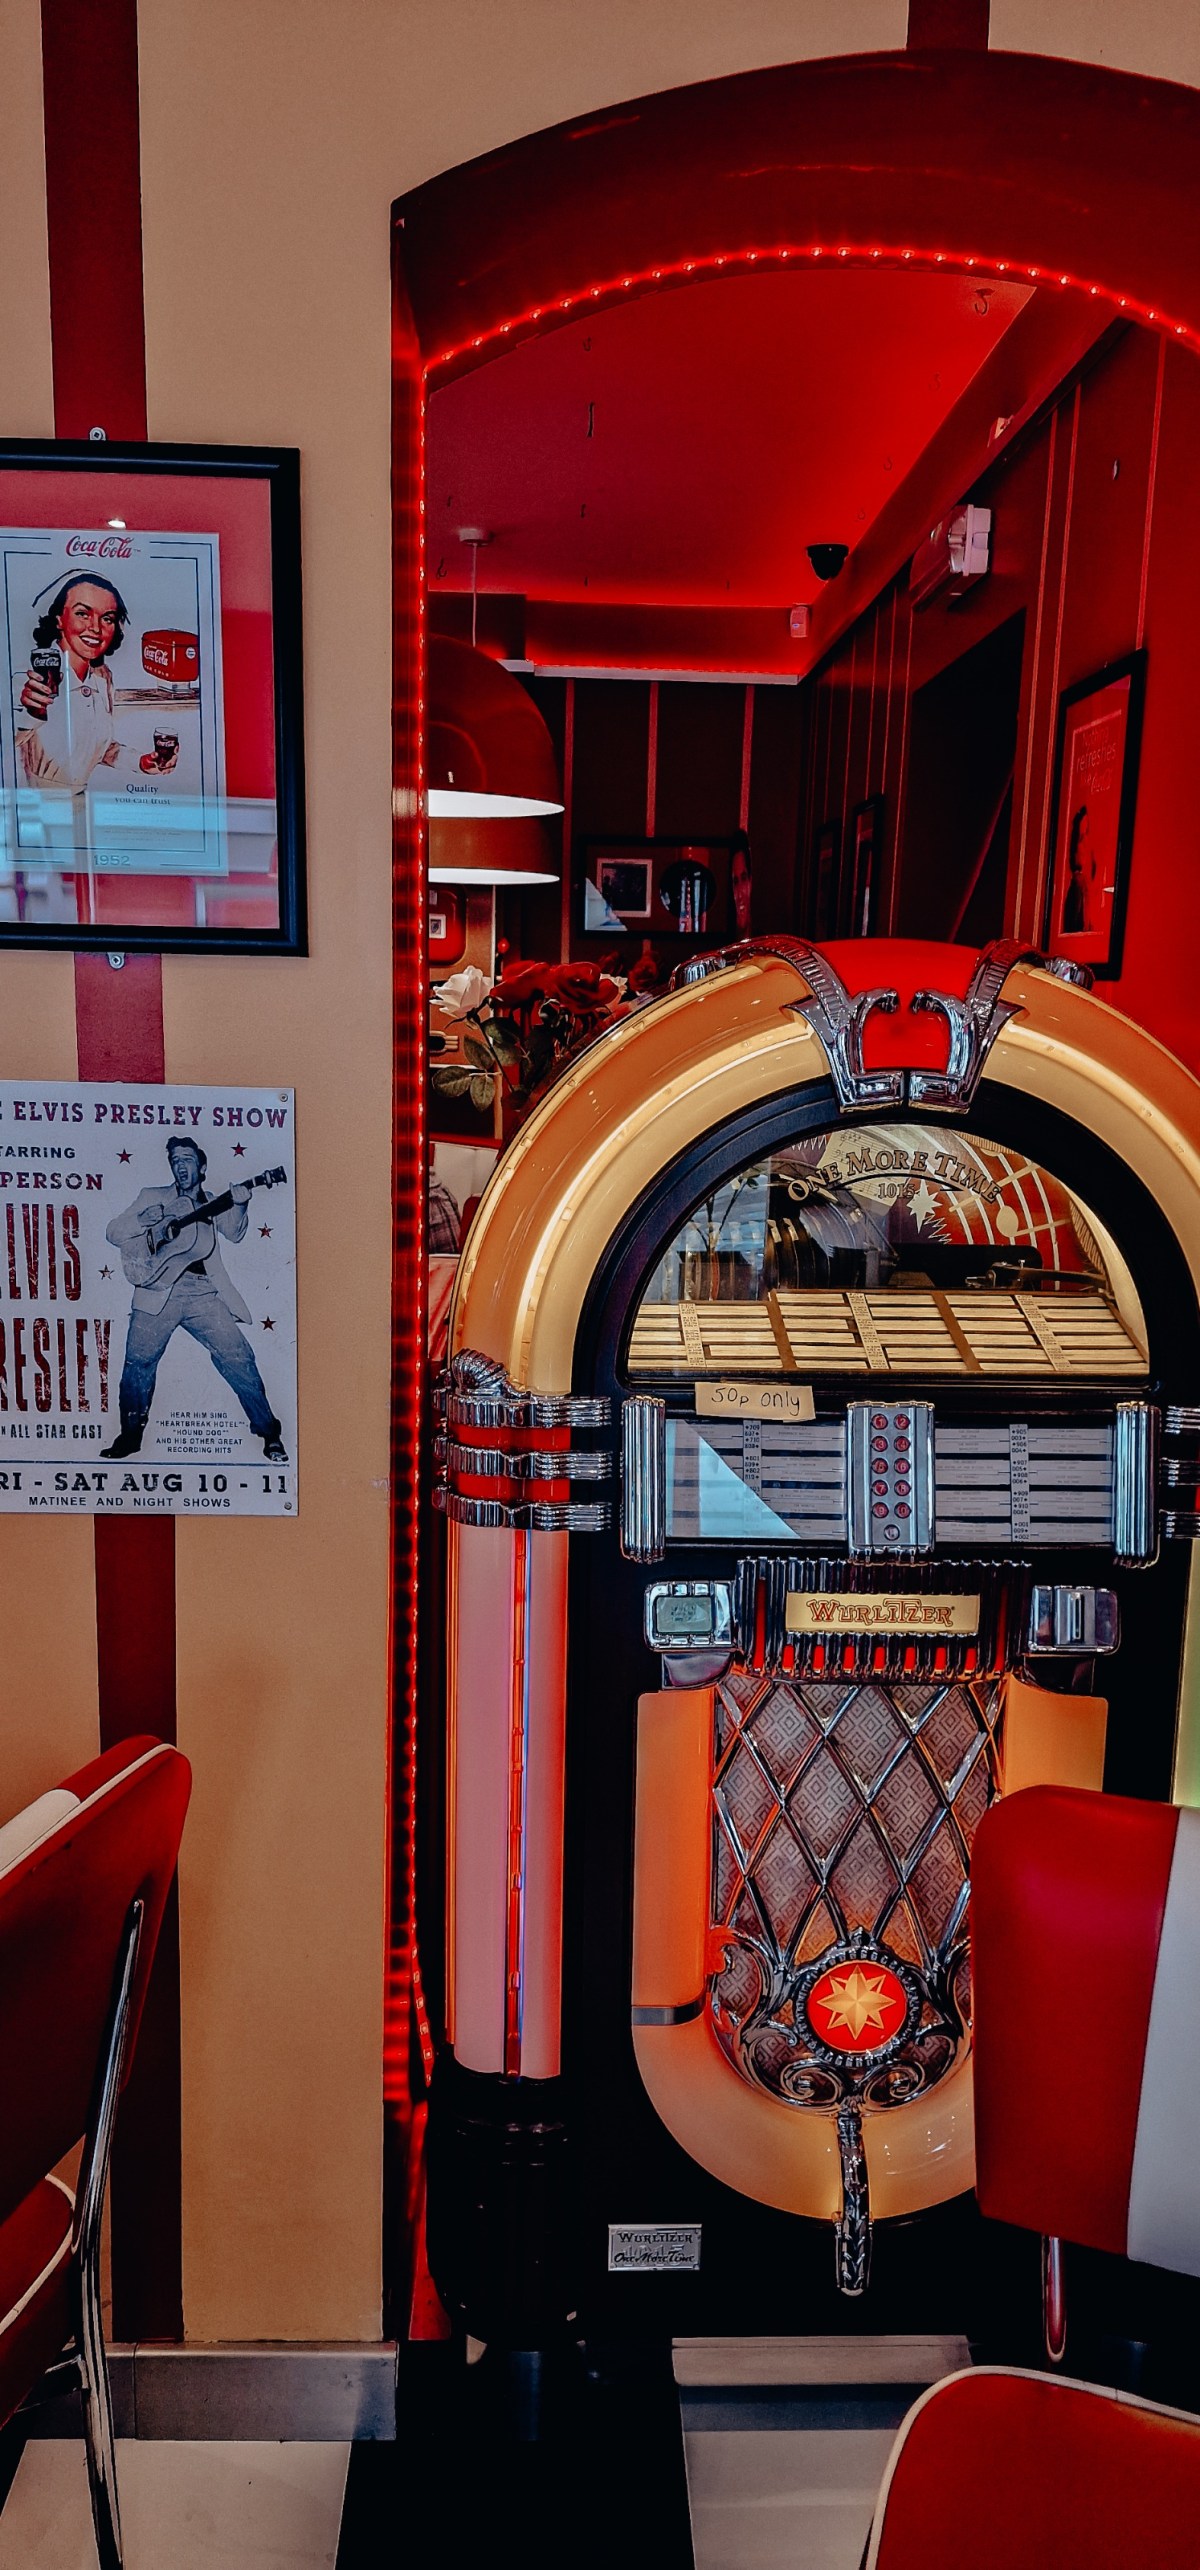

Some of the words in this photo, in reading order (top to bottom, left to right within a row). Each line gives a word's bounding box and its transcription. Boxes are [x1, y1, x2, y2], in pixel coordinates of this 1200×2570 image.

[65, 535, 134, 559] Coca-Cola
[126, 784, 159, 794] Quality
[115, 797, 131, 805] you
[151, 797, 171, 805] trust
[93, 854, 131, 866] 1952
[13, 1101, 84, 1122] ELVIS
[94, 1103, 202, 1126] PRESLEY
[212, 1106, 287, 1129] SHOW
[0, 1171, 104, 1190] PERSON
[788, 1161, 843, 1202] ONE
[845, 1146, 929, 1177] MORE
[934, 1150, 1002, 1204] TIME
[878, 1183, 915, 1199] 1015
[0, 1203, 82, 1302] LVIS
[711, 1387, 749, 1407] 50p
[761, 1390, 800, 1416] only
[193, 1411, 207, 1419] HIM
[10, 1423, 31, 1439] ALL
[36, 1424, 66, 1439] STAR
[72, 1424, 102, 1439] CAST
[167, 1446, 212, 1454] RECORDING
[55, 1472, 108, 1491] SAT
[120, 1473, 183, 1492] AUG
[199, 1474, 227, 1493] 10
[262, 1475, 287, 1493] 11
[29, 1496, 87, 1506] MATINEE
[96, 1497, 124, 1506] AND
[133, 1497, 173, 1507] NIGHT
[183, 1498, 231, 1507] SHOWS
[806, 1597, 953, 1627] WURLITZER
[618, 2231, 693, 2244] WURLITZER
[614, 2252, 636, 2263] One
[635, 2252, 668, 2263] More
[668, 2249, 695, 2263] Time
